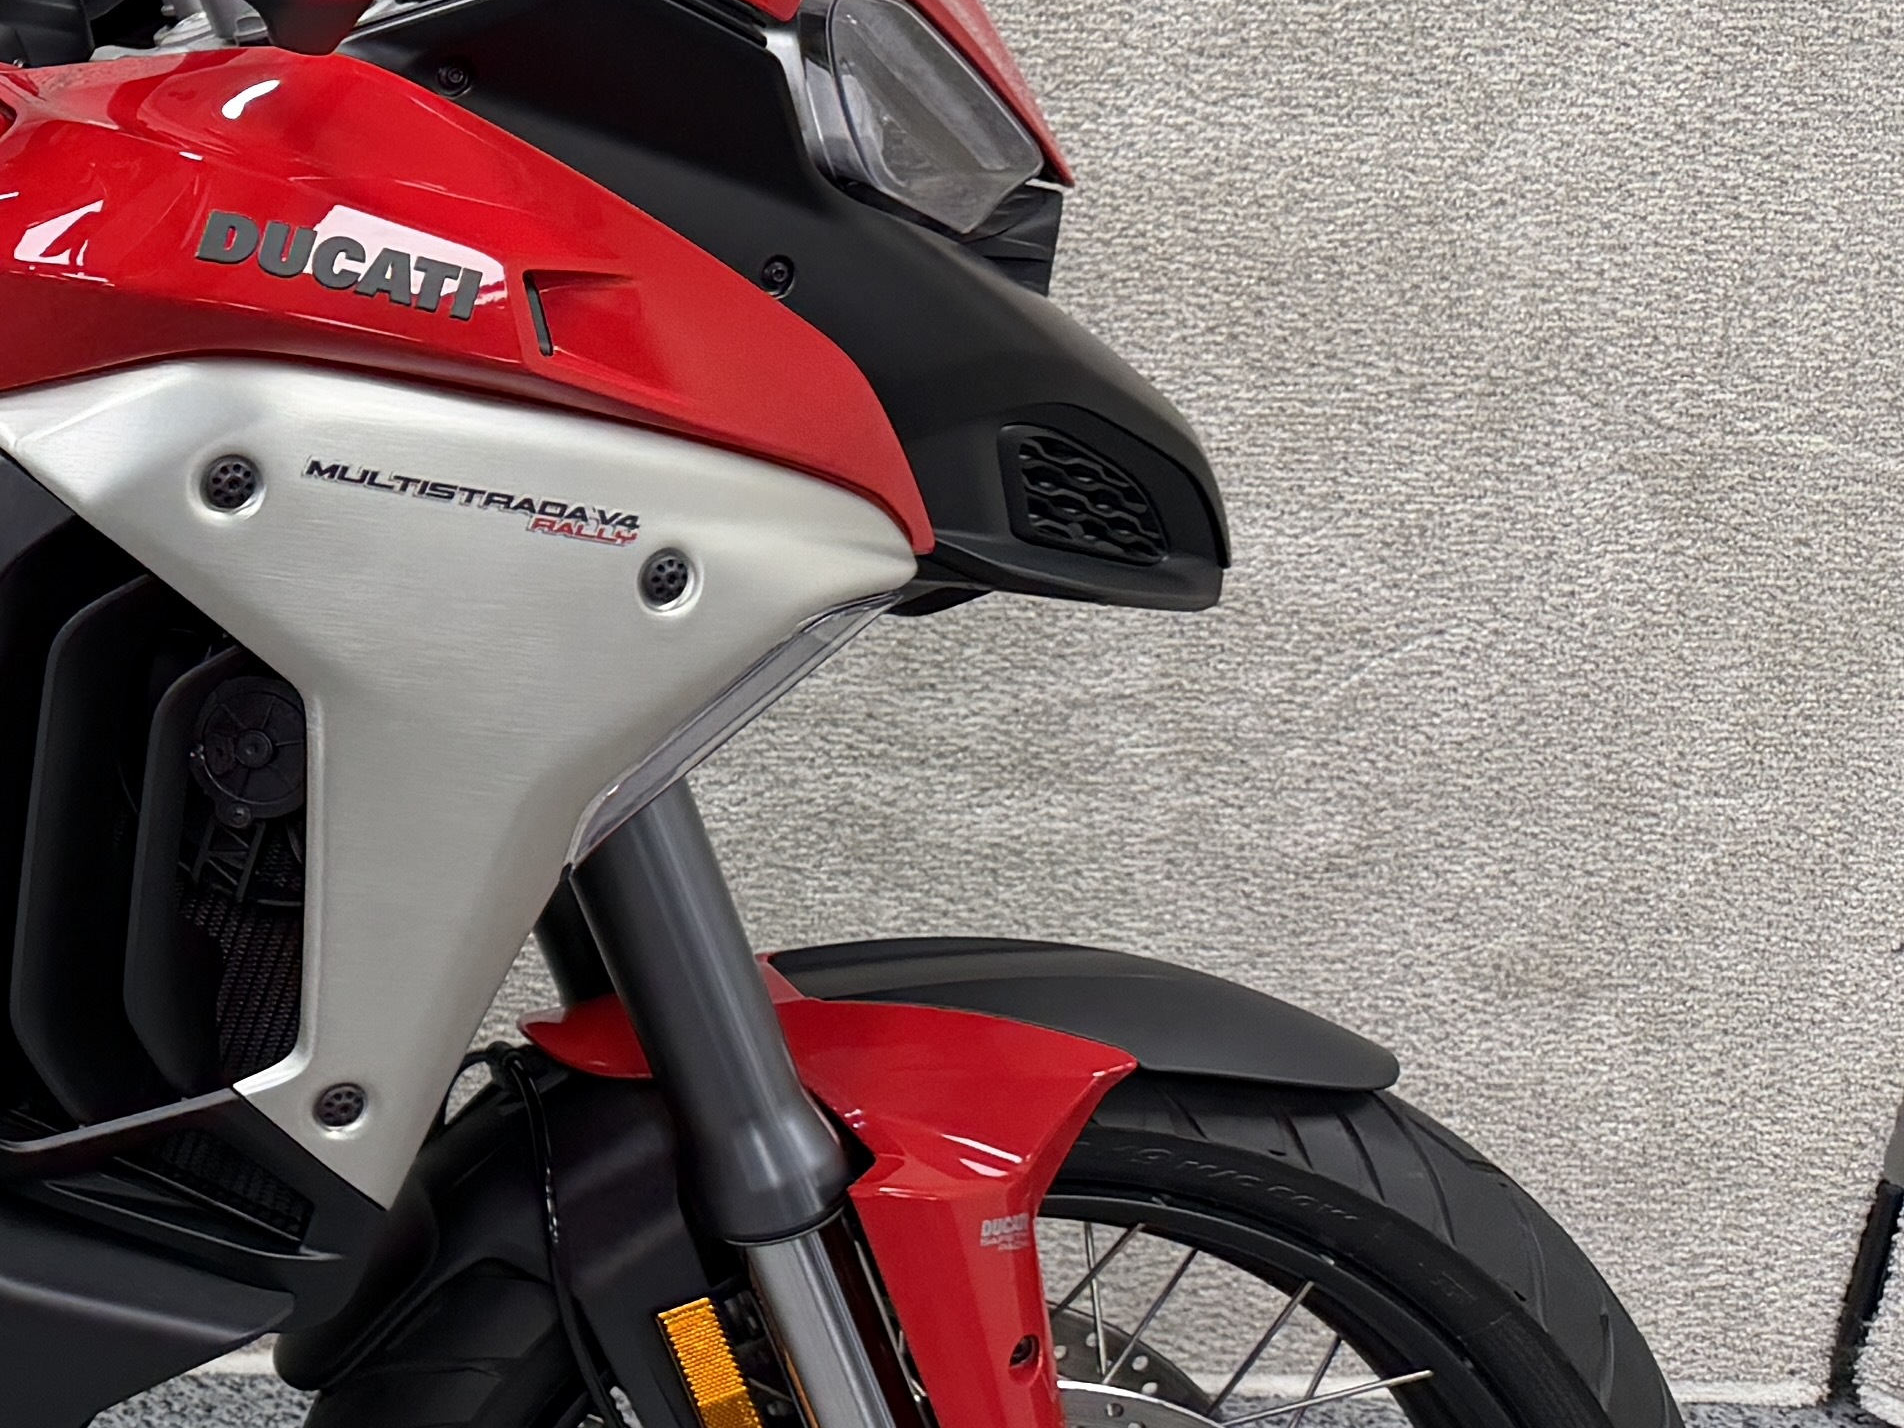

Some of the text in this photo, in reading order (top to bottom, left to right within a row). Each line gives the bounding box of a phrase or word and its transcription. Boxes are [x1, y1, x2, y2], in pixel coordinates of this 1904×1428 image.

[195, 209, 483, 321] DUCATI
[304, 459, 641, 531] MULTISTRADA V4
[530, 516, 639, 545] RALLY
